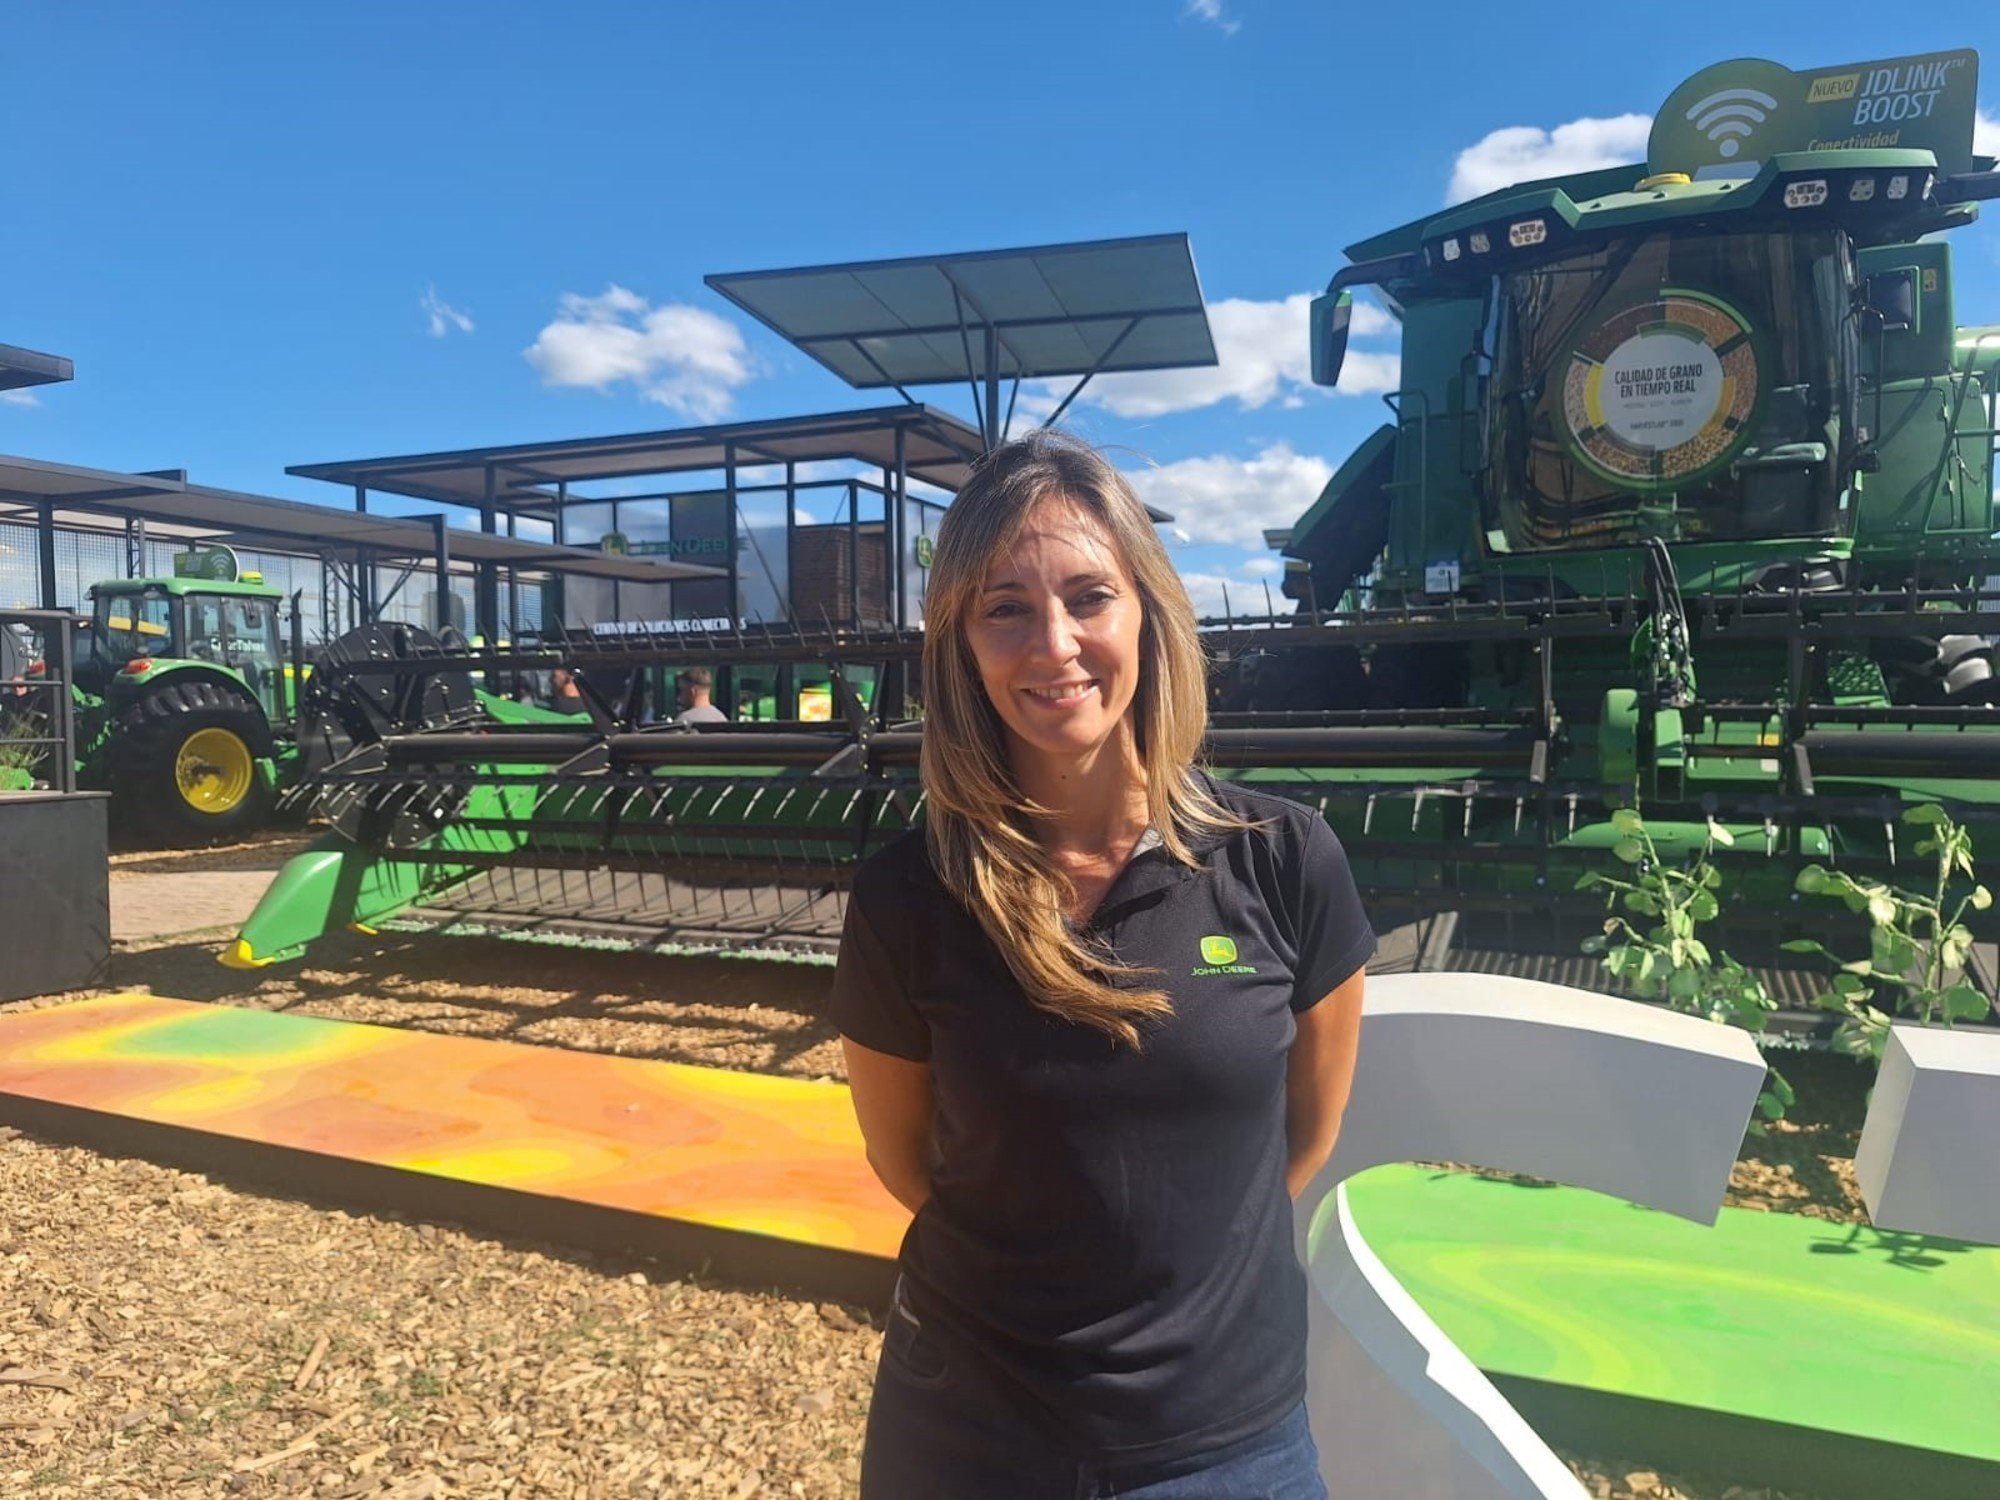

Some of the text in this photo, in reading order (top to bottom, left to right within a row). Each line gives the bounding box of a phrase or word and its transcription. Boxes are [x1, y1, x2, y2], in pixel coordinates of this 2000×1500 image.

[1813, 79, 1855, 97] NUEVO
[1853, 90, 1941, 125] BOOST
[1807, 130, 1900, 150] Conectividad
[1615, 363, 1703, 384] CALIDAD DE GRANO
[1620, 379, 1696, 398] EN TIEMPO REAL
[1190, 965, 1257, 976] JOHN DEERE
